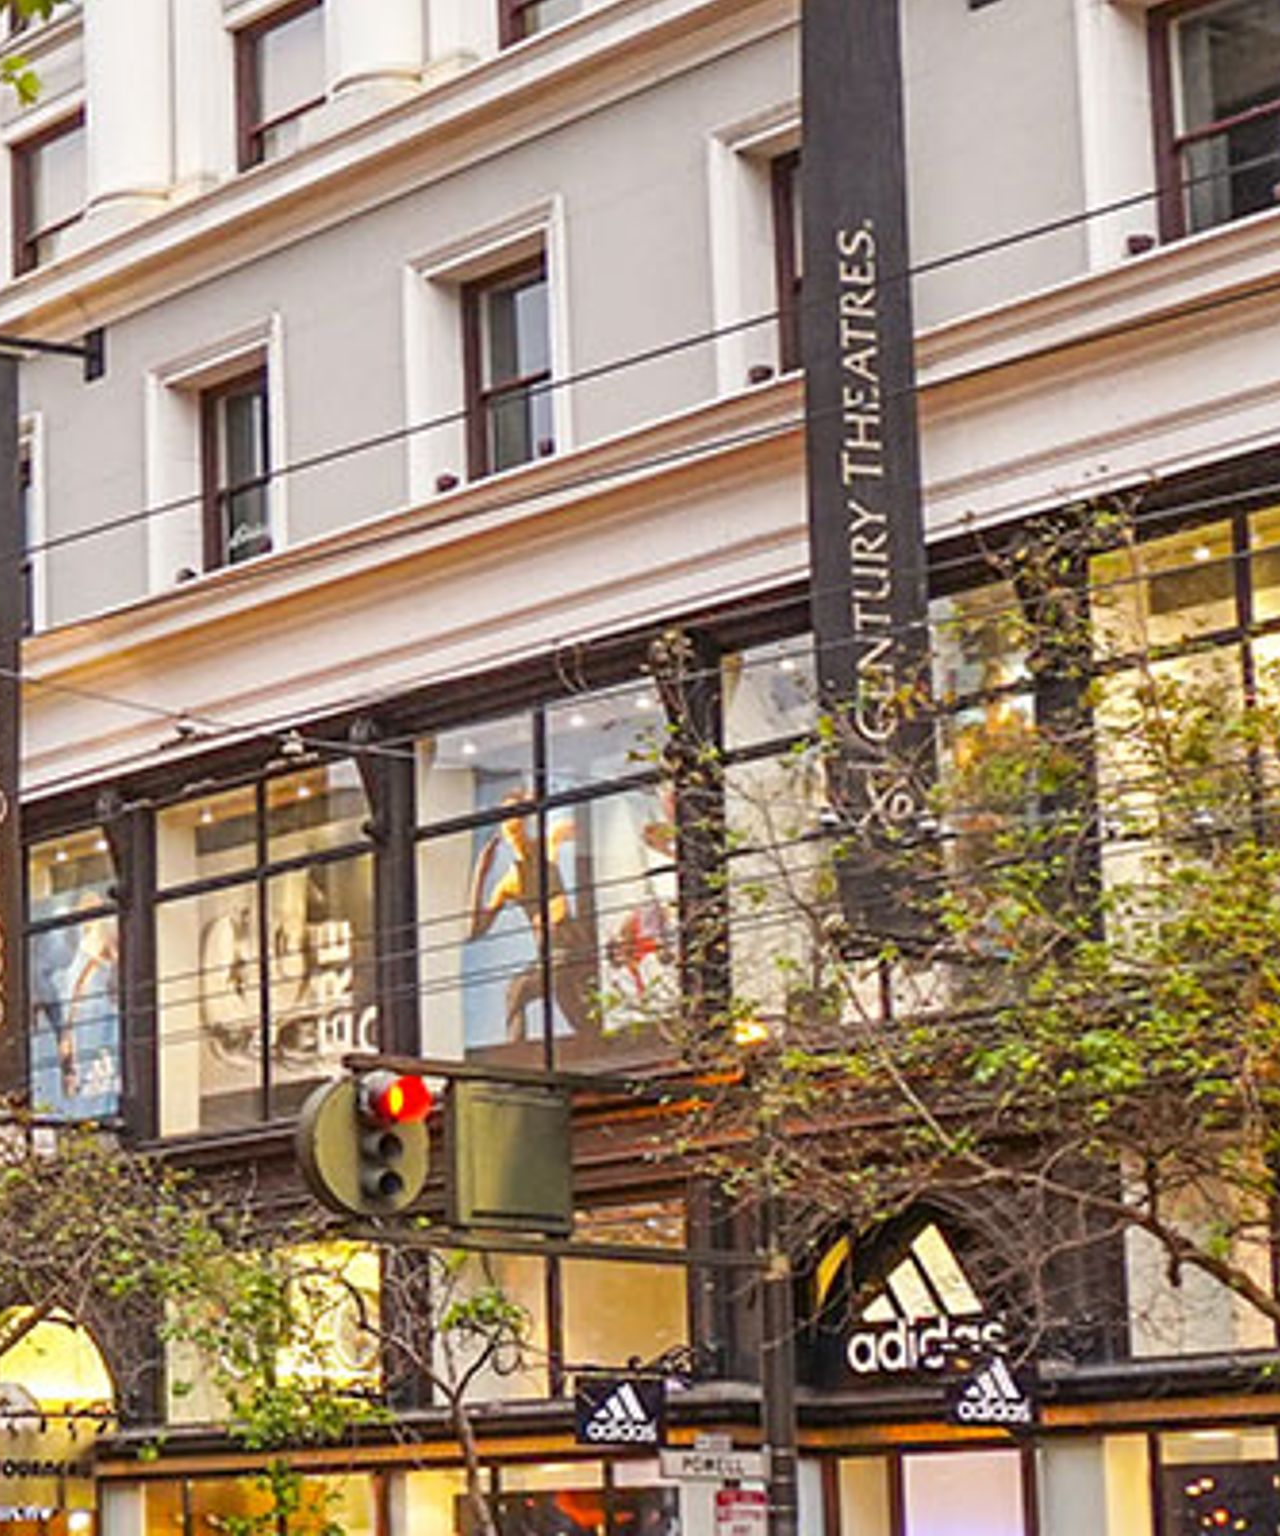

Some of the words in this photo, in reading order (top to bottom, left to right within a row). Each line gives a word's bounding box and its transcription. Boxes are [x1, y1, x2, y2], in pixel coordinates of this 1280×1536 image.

[847, 1314, 1008, 1373] adidas
[957, 1399, 1032, 1422] adidas
[586, 1418, 657, 1441] adidas
